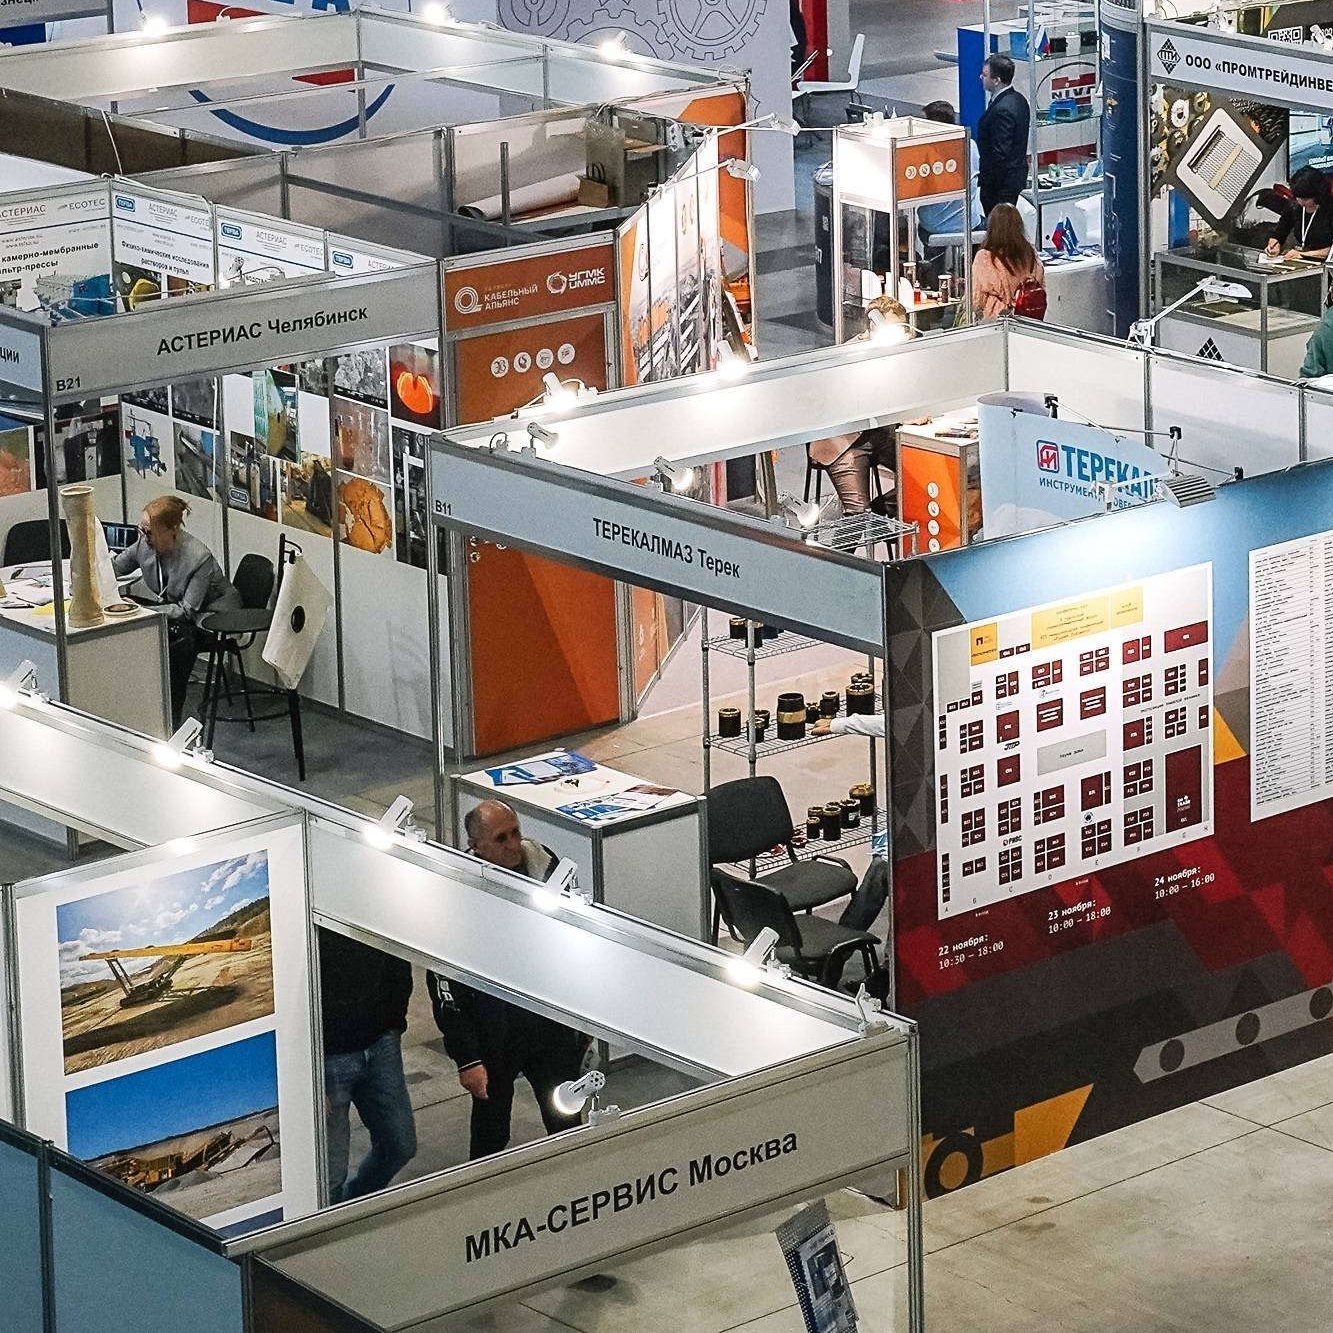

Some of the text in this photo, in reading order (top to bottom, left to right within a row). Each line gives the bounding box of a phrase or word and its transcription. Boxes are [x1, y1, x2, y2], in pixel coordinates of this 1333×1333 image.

[1185, 54, 1211, 70] ООО
[69, 198, 105, 211] ECOTEC
[148, 203, 178, 217] АСТЕРИАС
[256, 231, 287, 246] АСТЕРИАС
[1, 242, 99, 263] камерно-мембранные
[569, 267, 605, 281] УГМК
[569, 276, 605, 289] UMMC
[484, 284, 538, 302] КАБЕЛЬНЫЙ
[485, 298, 519, 310] АЛЬЯНС
[156, 305, 368, 356] АСТЕРИАС Челябинск
[56, 376, 82, 392] B21
[435, 500, 453, 516] B11
[592, 516, 741, 579] ТЕРЕКАЛМАЗ Терек
[1155, 867, 1200, 886] 24 ноября:
[1155, 873, 1215, 900] 10:00 16:00
[1048, 900, 1096, 920] 23 ноября:
[1048, 907, 1111, 934] 10:00 18:00
[938, 934, 988, 956] 22 ноября:
[939, 941, 1004, 970] 10:30 18:00
[464, 1129, 799, 1265] МКА-СЕРВИС Москва
